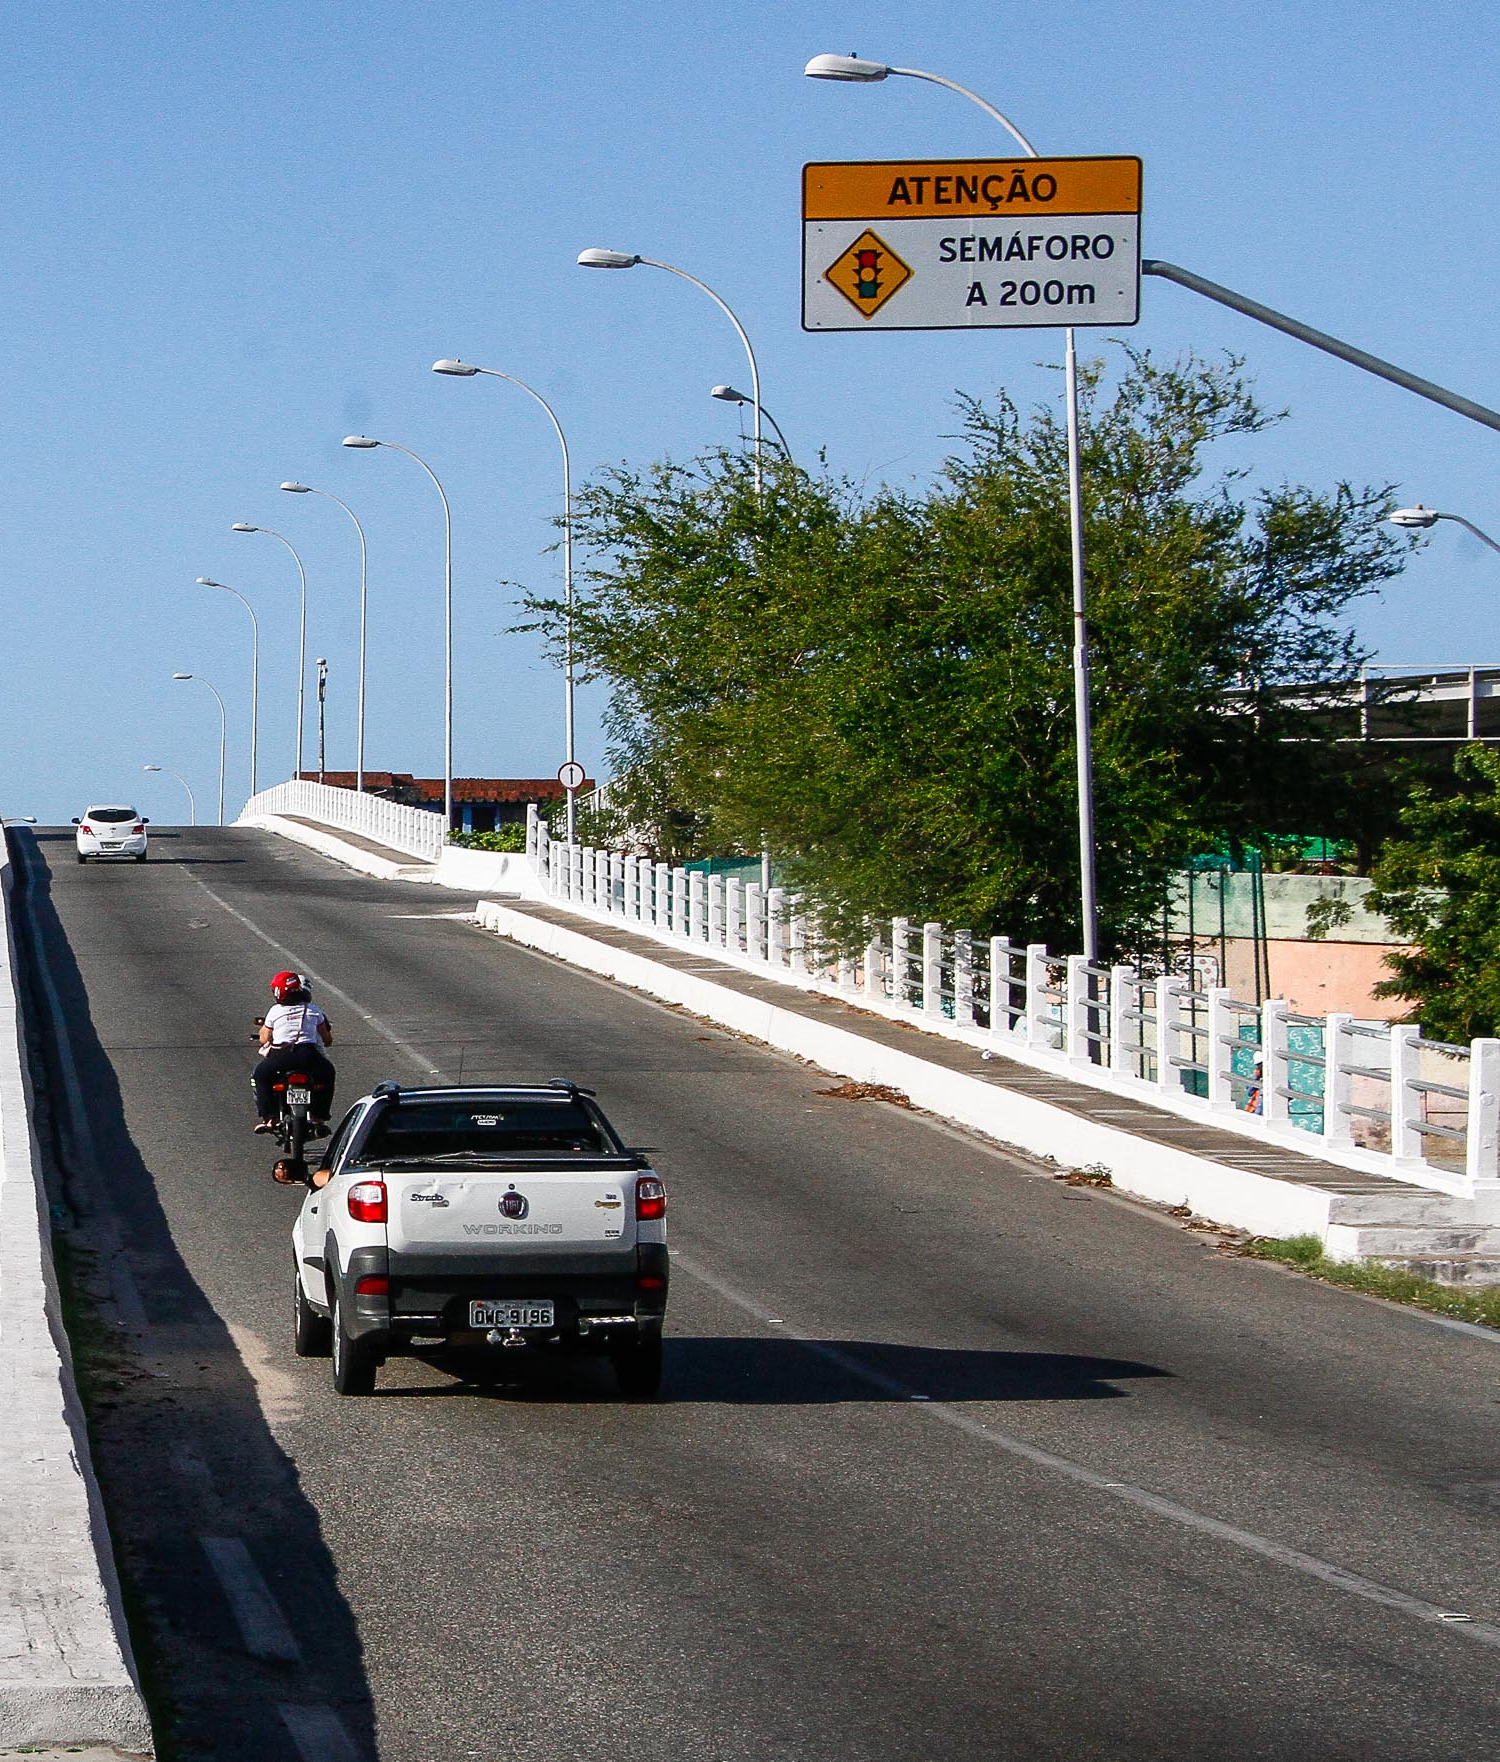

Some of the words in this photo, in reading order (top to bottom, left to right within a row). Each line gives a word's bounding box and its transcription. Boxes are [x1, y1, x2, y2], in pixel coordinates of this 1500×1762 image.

[887, 169, 1057, 210] ATENÇÃO
[939, 231, 1115, 262] SEMÁFORO
[966, 282, 988, 307] A
[1000, 281, 1096, 306] 200m
[462, 1223, 563, 1235] WORKING
